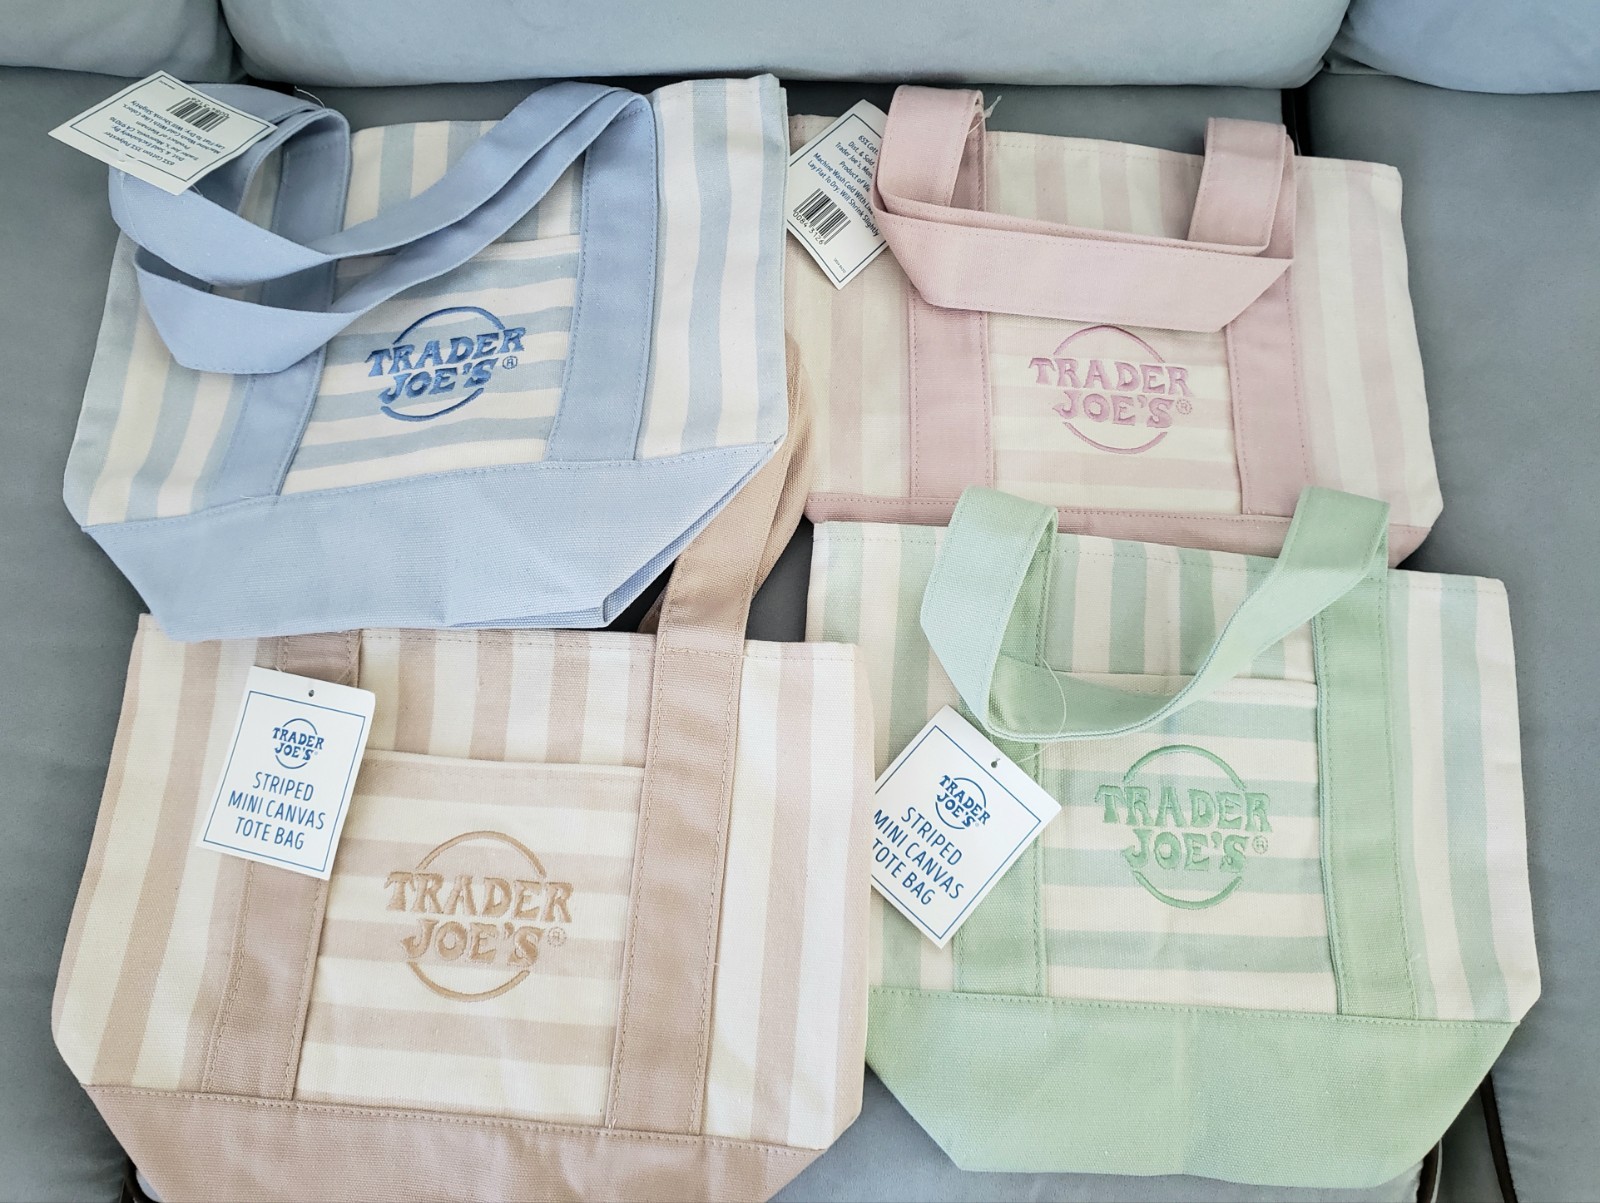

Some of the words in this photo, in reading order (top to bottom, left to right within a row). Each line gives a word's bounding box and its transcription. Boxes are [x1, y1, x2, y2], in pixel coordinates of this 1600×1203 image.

[131, 100, 154, 115] Slightly
[835, 142, 851, 157] Trader
[858, 135, 870, 146] 65%
[867, 143, 881, 156] Cott
[863, 154, 876, 166] Sold
[813, 152, 834, 172] Machine
[832, 169, 846, 184] Wash
[844, 181, 857, 194] Cold
[854, 190, 867, 205] With
[839, 161, 859, 180] Product
[808, 160, 817, 171] Lay
[815, 167, 827, 179] Flat
[825, 175, 832, 184] To
[840, 189, 851, 202] Will
[849, 199, 865, 217] Shrink
[862, 215, 880, 237] Slightly
[792, 210, 808, 228] 0084
[808, 227, 825, 245] 3126
[365, 327, 527, 377] TRADER
[378, 358, 499, 404] JOE'S
[1028, 357, 1194, 396] TRADER
[1052, 390, 1175, 428] JOE'S
[272, 727, 325, 750] TRADER
[274, 742, 314, 761] JOE'S
[252, 771, 315, 802] STRIPED
[938, 774, 991, 826] TRADER
[227, 790, 264, 815] MINI
[265, 800, 326, 830] CANVAS
[936, 793, 978, 828] JOE'S
[1094, 784, 1272, 833] TRADER
[235, 816, 272, 842] TOTE
[274, 827, 305, 850] BAG
[901, 807, 963, 866] STRIPED
[1120, 829, 1249, 873] JOE'S
[873, 838, 907, 878] TOTE
[902, 871, 936, 905] BAG
[874, 809, 908, 848] MINI
[905, 842, 965, 900] CANVAS
[384, 871, 574, 923] TRADER
[400, 918, 547, 967] JOE'S
